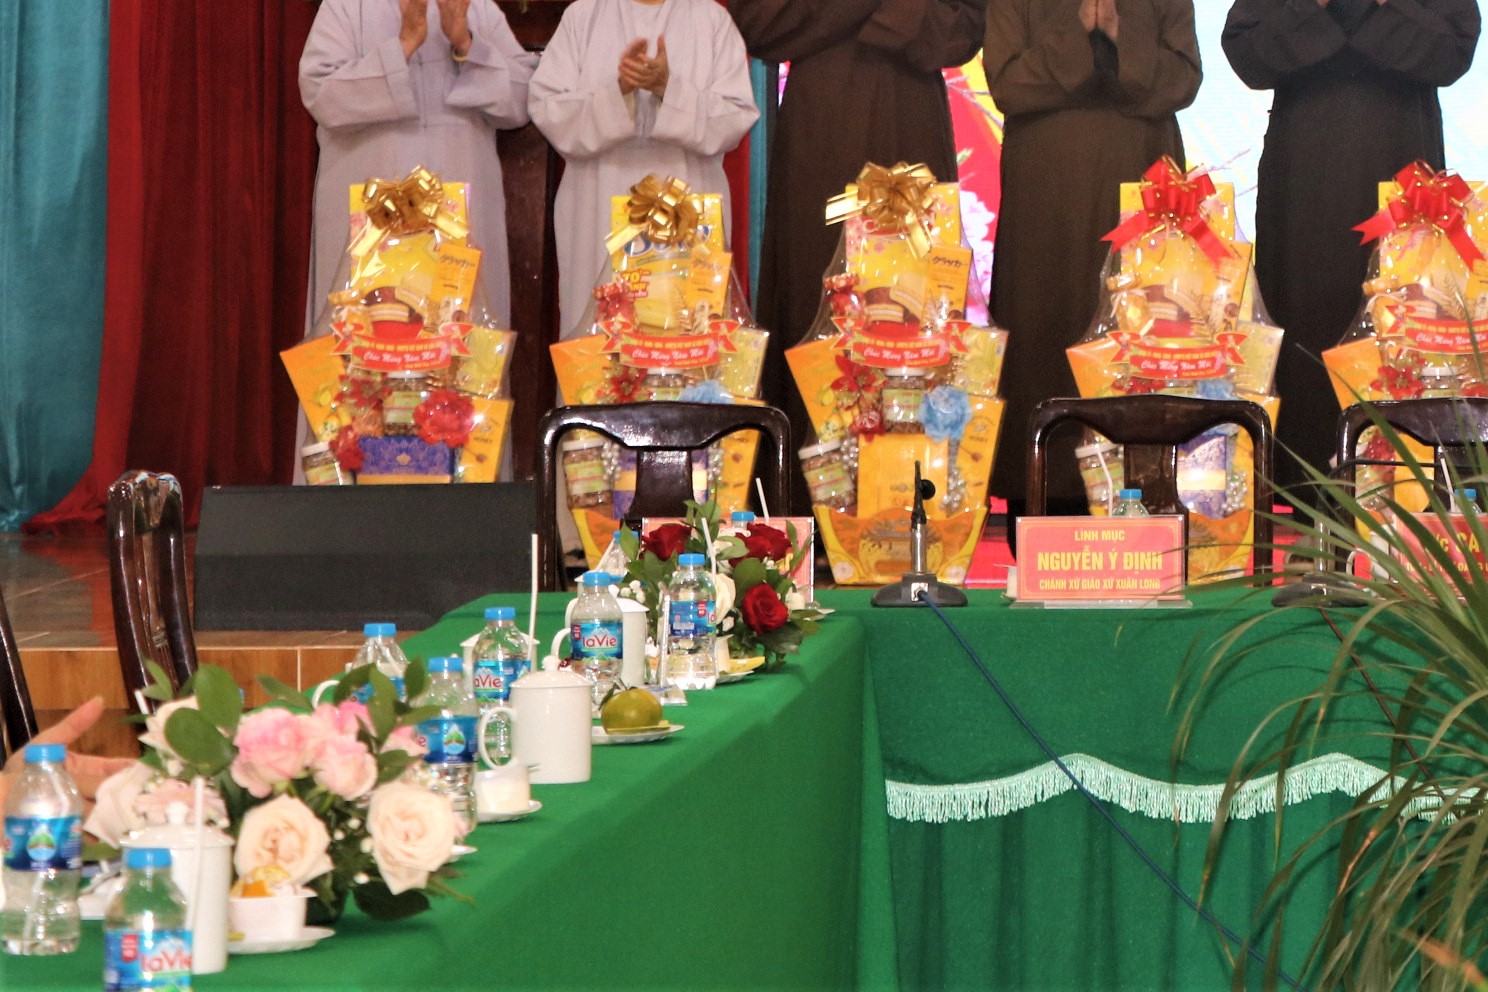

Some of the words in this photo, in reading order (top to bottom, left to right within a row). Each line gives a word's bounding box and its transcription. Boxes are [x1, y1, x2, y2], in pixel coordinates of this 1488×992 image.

[1101, 530, 1125, 543] MỤC
[1037, 545, 1104, 571] NGUYỄN
[1108, 548, 1119, 571] Ý
[1123, 551, 1163, 575] ĐỊNH
[582, 634, 617, 648] laVie
